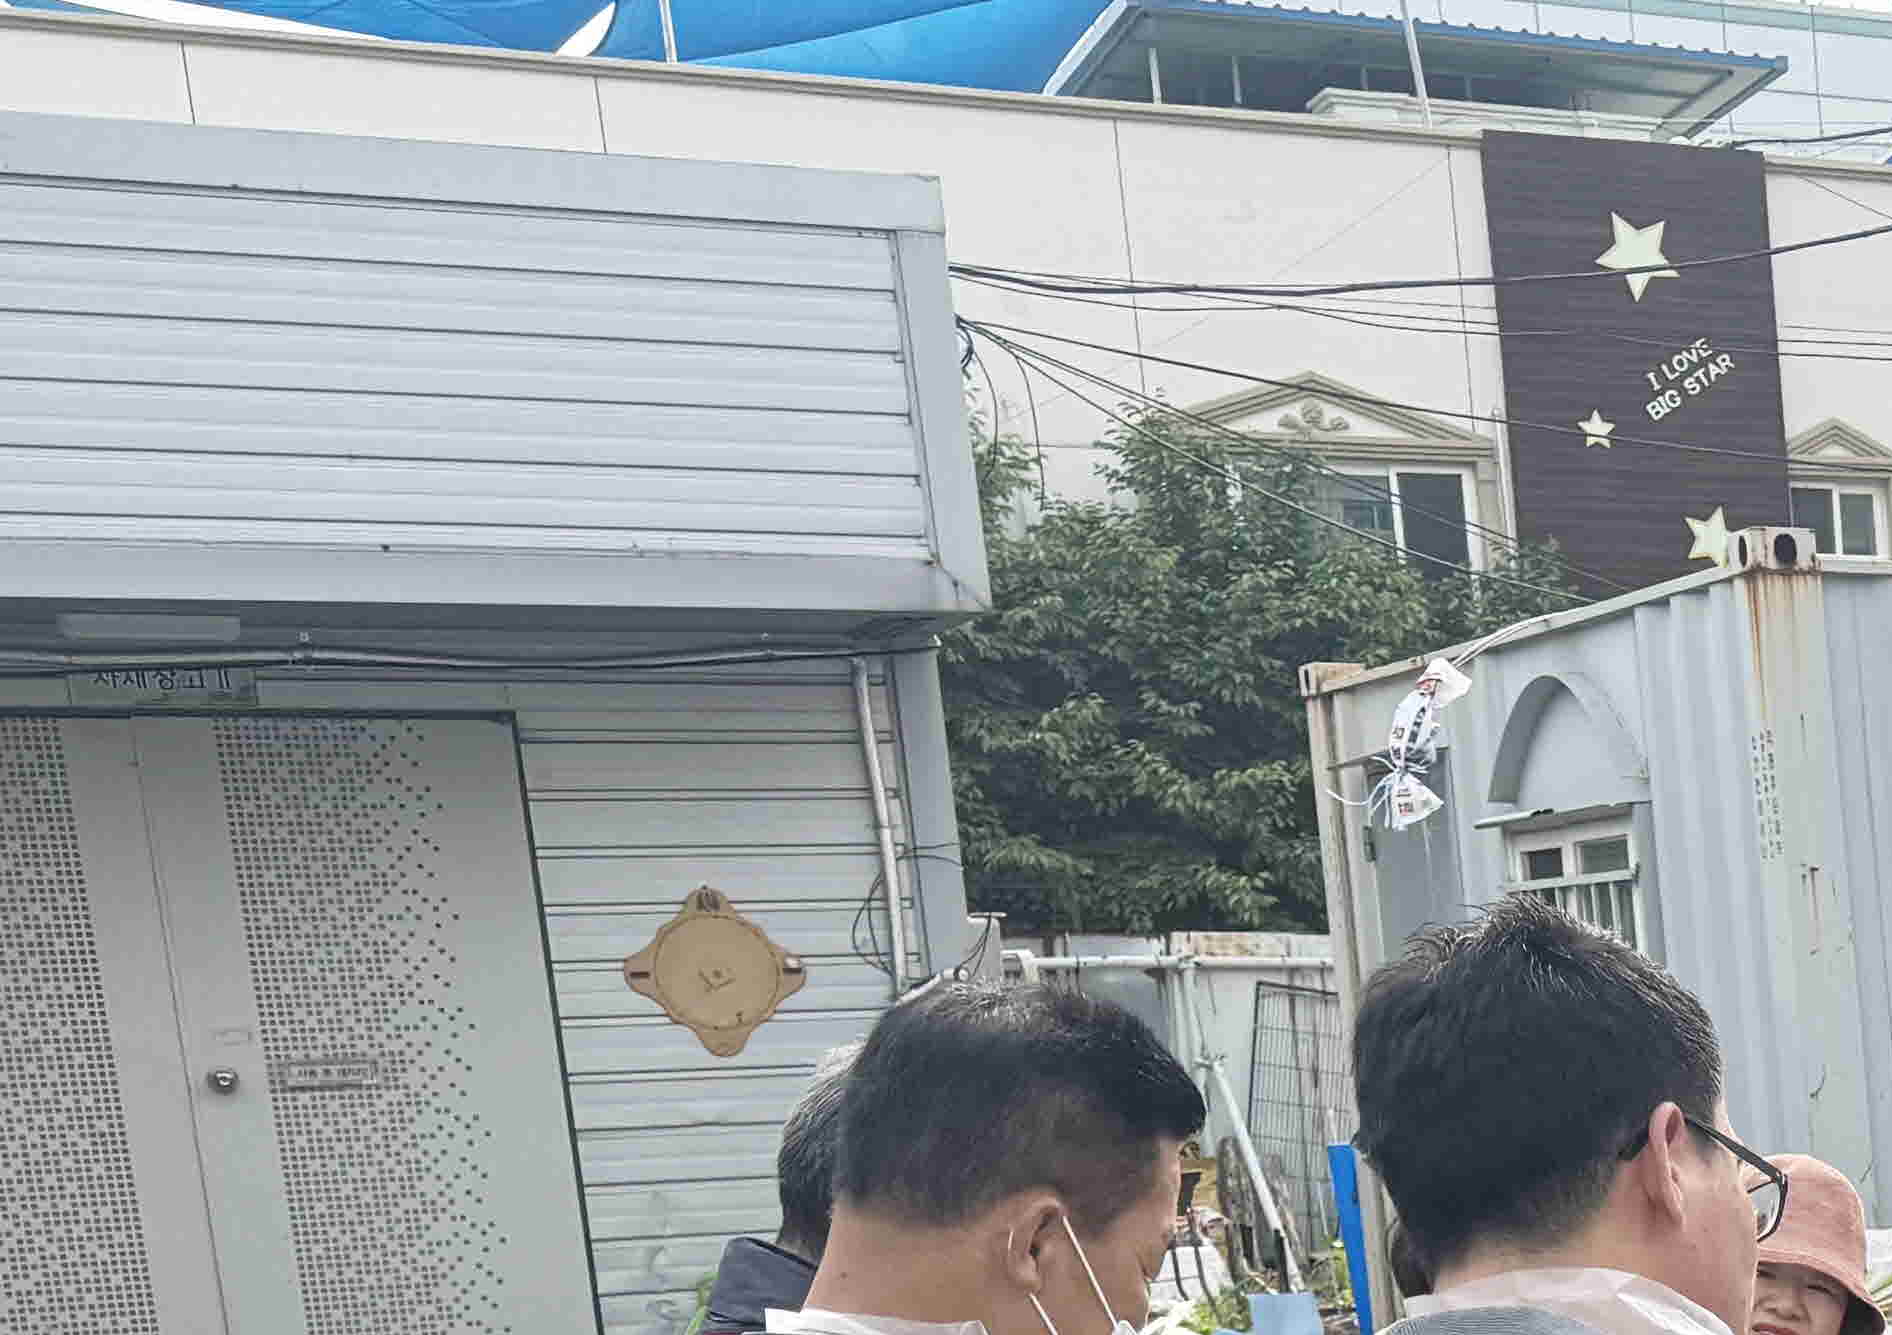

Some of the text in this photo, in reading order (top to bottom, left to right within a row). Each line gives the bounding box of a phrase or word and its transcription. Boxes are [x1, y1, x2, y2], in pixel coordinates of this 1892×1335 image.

[1645, 353, 1736, 421] BIG STAR
[1647, 337, 1713, 391] I LOVE
